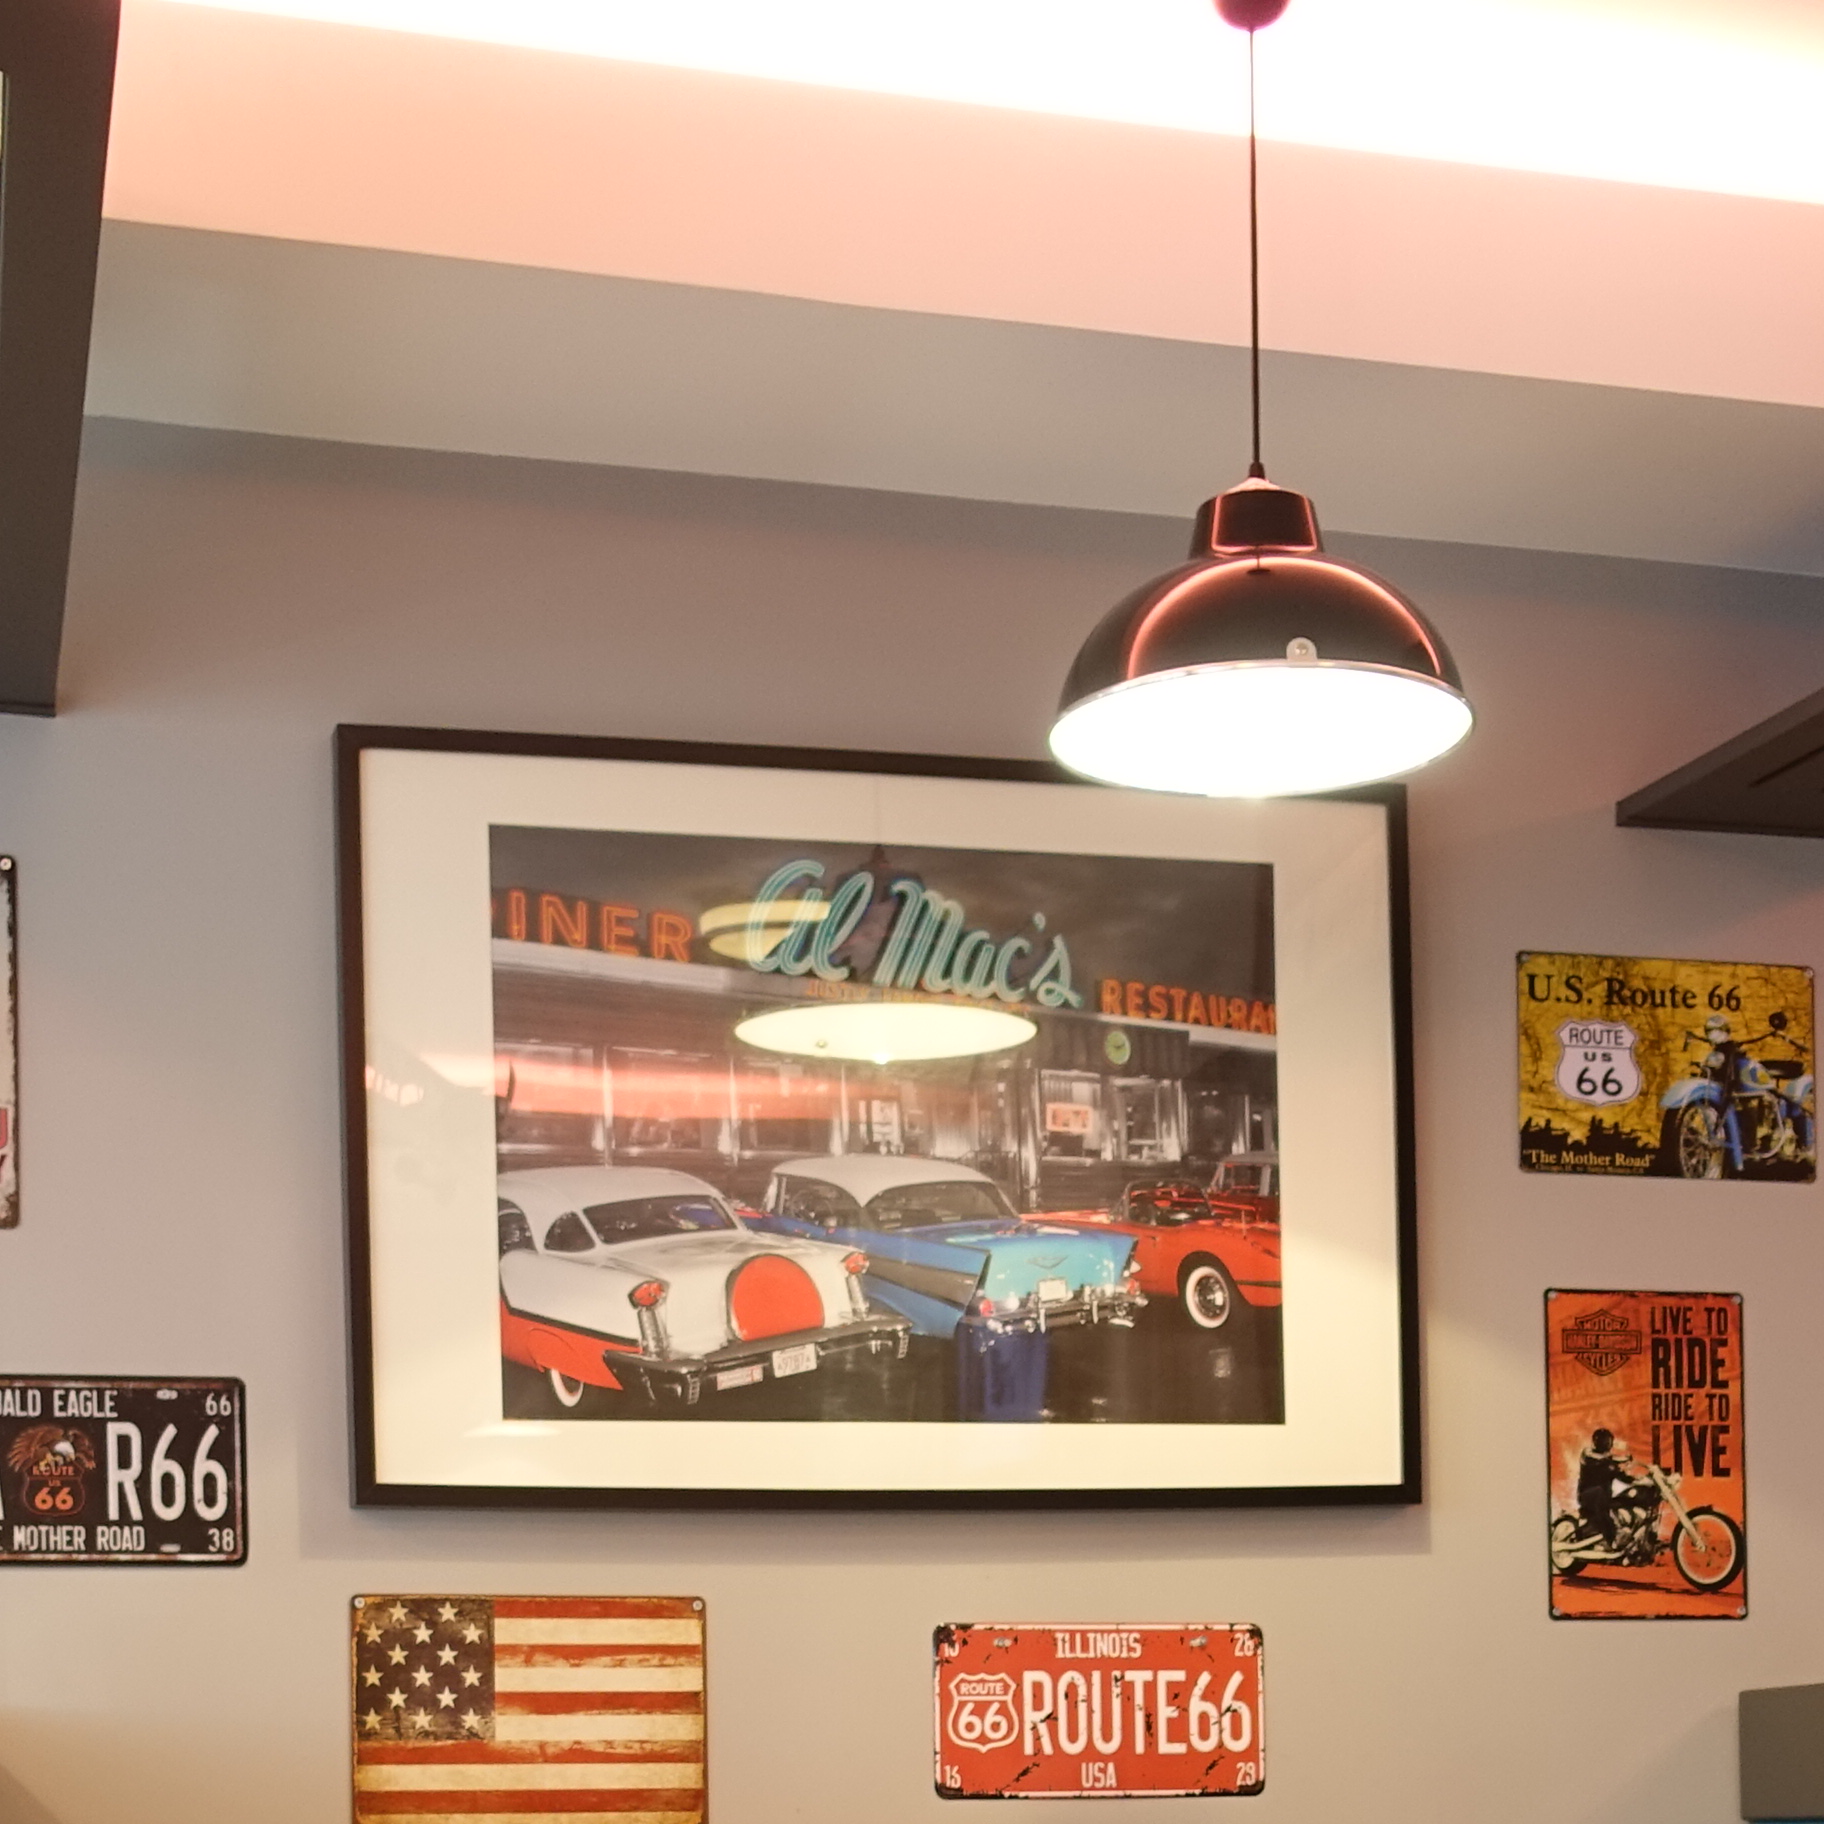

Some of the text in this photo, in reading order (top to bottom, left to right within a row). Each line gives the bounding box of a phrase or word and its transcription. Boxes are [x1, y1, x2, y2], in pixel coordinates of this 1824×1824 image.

[746, 858, 874, 983] Al
[873, 877, 1084, 1009] Mac's
[1526, 974, 1741, 1011] U.S. Route 66
[1568, 1027, 1624, 1046] ROUTE
[1576, 1067, 1623, 1096] 66
[1560, 1151, 1613, 1167] Mother
[1651, 1306, 1728, 1335] LIVE TO
[1651, 1337, 1729, 1389] RIDE
[53, 1389, 118, 1419] EAGLE
[205, 1393, 232, 1416] 66
[1651, 1393, 1730, 1422] RIDE TO
[1651, 1425, 1731, 1477] LIVE
[107, 1421, 228, 1521] R66
[34, 1487, 74, 1511] 66
[13, 1525, 86, 1552] MOTHER
[97, 1526, 145, 1552] ROAD
[208, 1528, 235, 1552] 38
[1055, 1632, 1142, 1658] ILLINOIS
[960, 1682, 1004, 1695] ROUTE
[958, 1702, 1009, 1740] 66
[1023, 1669, 1252, 1755] ROUTE66
[1081, 1762, 1117, 1788] USA
